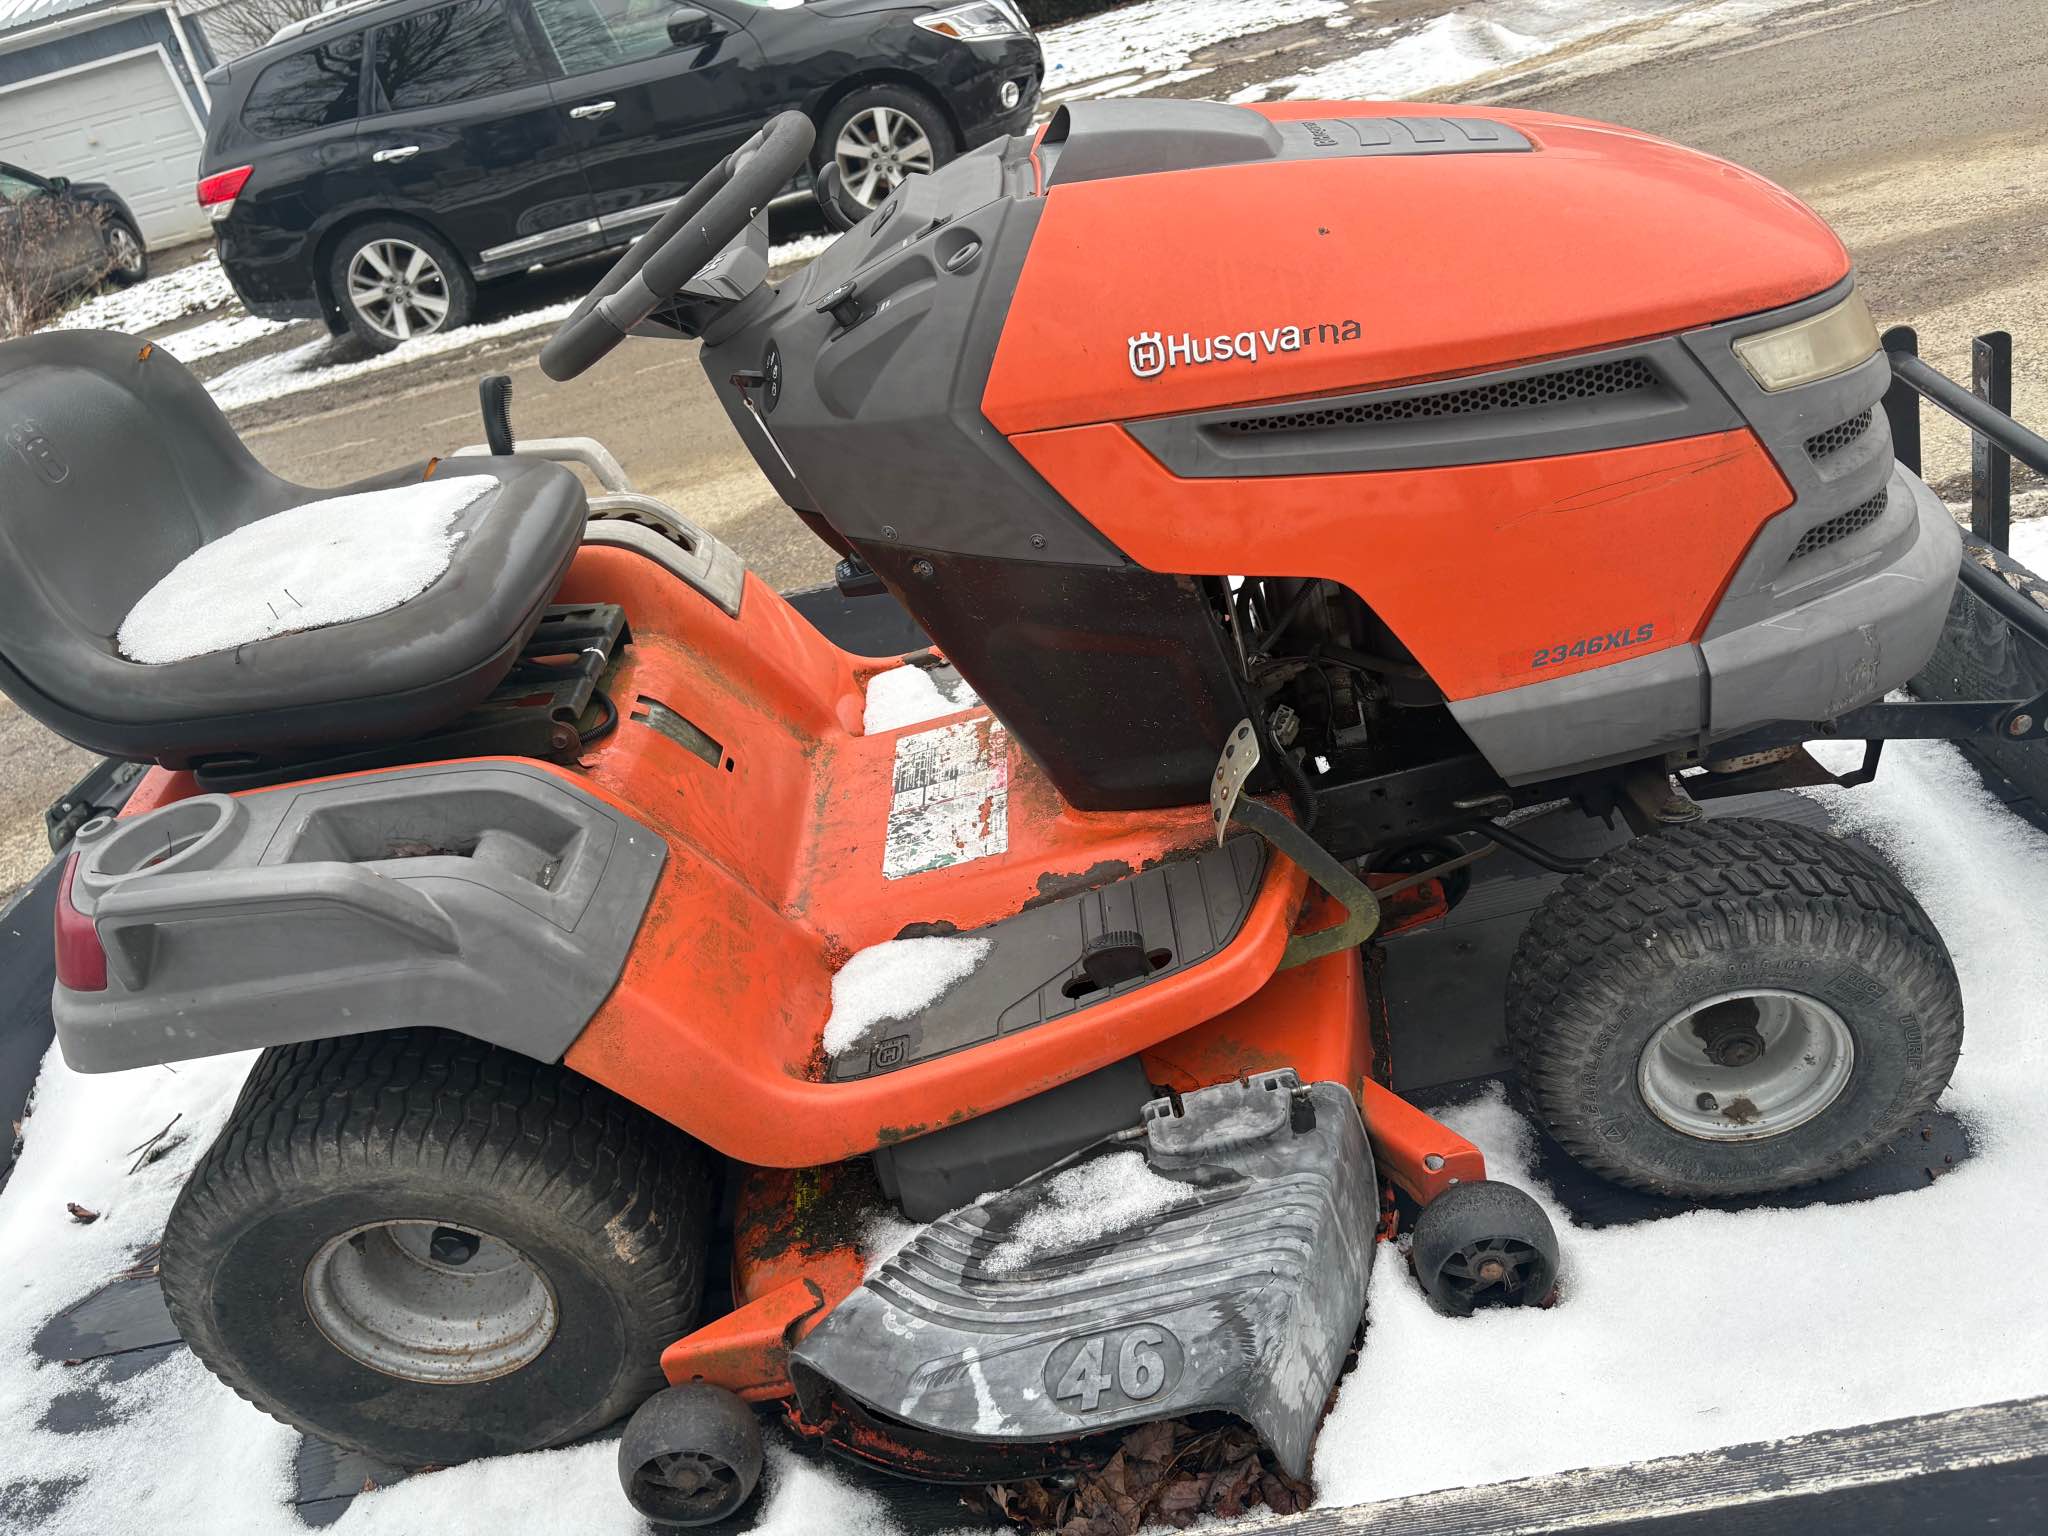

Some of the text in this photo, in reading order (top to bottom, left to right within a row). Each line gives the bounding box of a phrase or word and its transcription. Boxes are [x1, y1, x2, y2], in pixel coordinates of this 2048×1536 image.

[1167, 319, 1361, 368] Husqvarna
[1531, 623, 1654, 668] 2346XLS
[1900, 1012, 1923, 1071] TURF
[1056, 1328, 1165, 1413] 46
